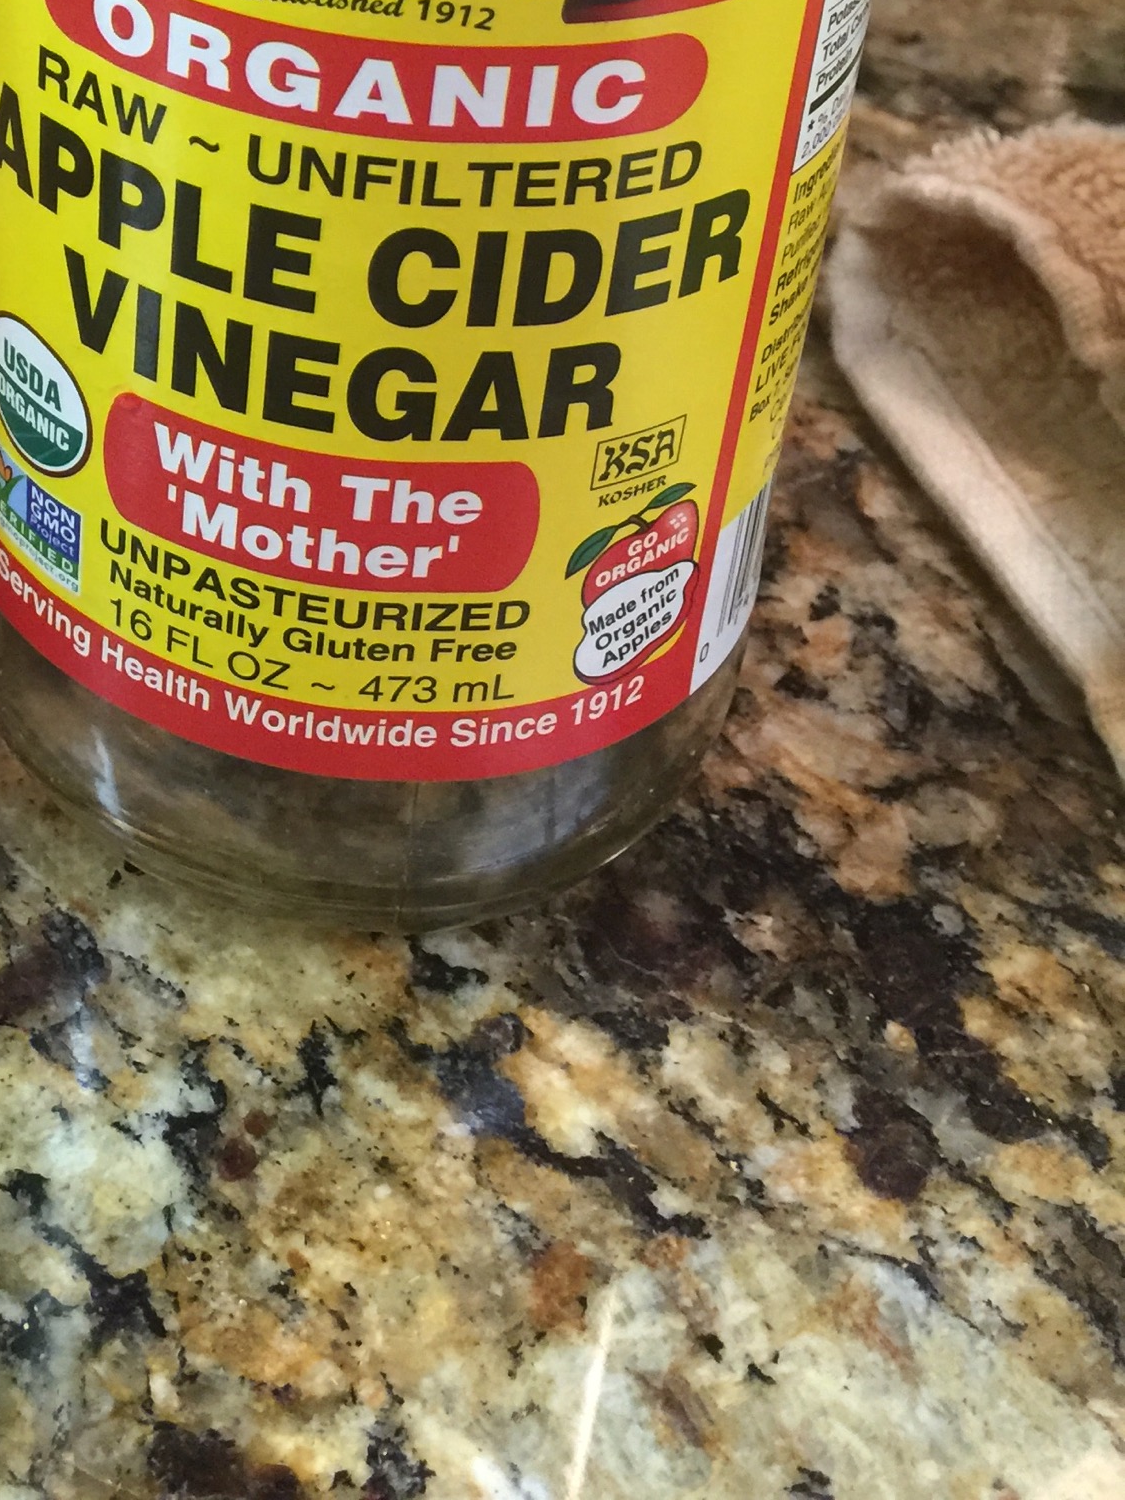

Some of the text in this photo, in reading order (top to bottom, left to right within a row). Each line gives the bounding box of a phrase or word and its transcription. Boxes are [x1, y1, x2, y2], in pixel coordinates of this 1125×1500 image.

[816, 47, 853, 93] Protein
[822, 23, 850, 63] Total
[37, 43, 167, 147] RAW
[246, 134, 704, 208] UNFILTERED
[787, 203, 814, 236] Raw
[366, 187, 752, 329] CIDER
[768, 278, 809, 327] Shake
[63, 244, 624, 444] VINEGAR
[3, 336, 63, 414] USDA
[748, 393, 771, 424] Box
[153, 420, 483, 525] With The
[597, 426, 676, 483] KSA
[30, 484, 75, 529] NON
[597, 474, 668, 508] KOSHER
[29, 514, 75, 558] Project
[30, 501, 76, 544] GMO
[167, 484, 461, 579] 'Mother'
[627, 531, 659, 557] GO
[99, 516, 531, 633] UNPASTEURIZED
[595, 529, 689, 588] ORGANIC
[109, 560, 517, 663] Naturally Gluten Free
[588, 567, 680, 637] Made from
[594, 588, 678, 651] Organic
[109, 598, 153, 642] 16
[165, 624, 214, 671] FL
[227, 650, 292, 691] OZ
[358, 675, 438, 704] 473
[452, 673, 515, 703] mL
[602, 610, 673, 668] Apples
[101, 635, 211, 712] Health
[224, 690, 437, 748] Worldwide
[450, 711, 558, 748] Since
[570, 674, 645, 727] 1912
